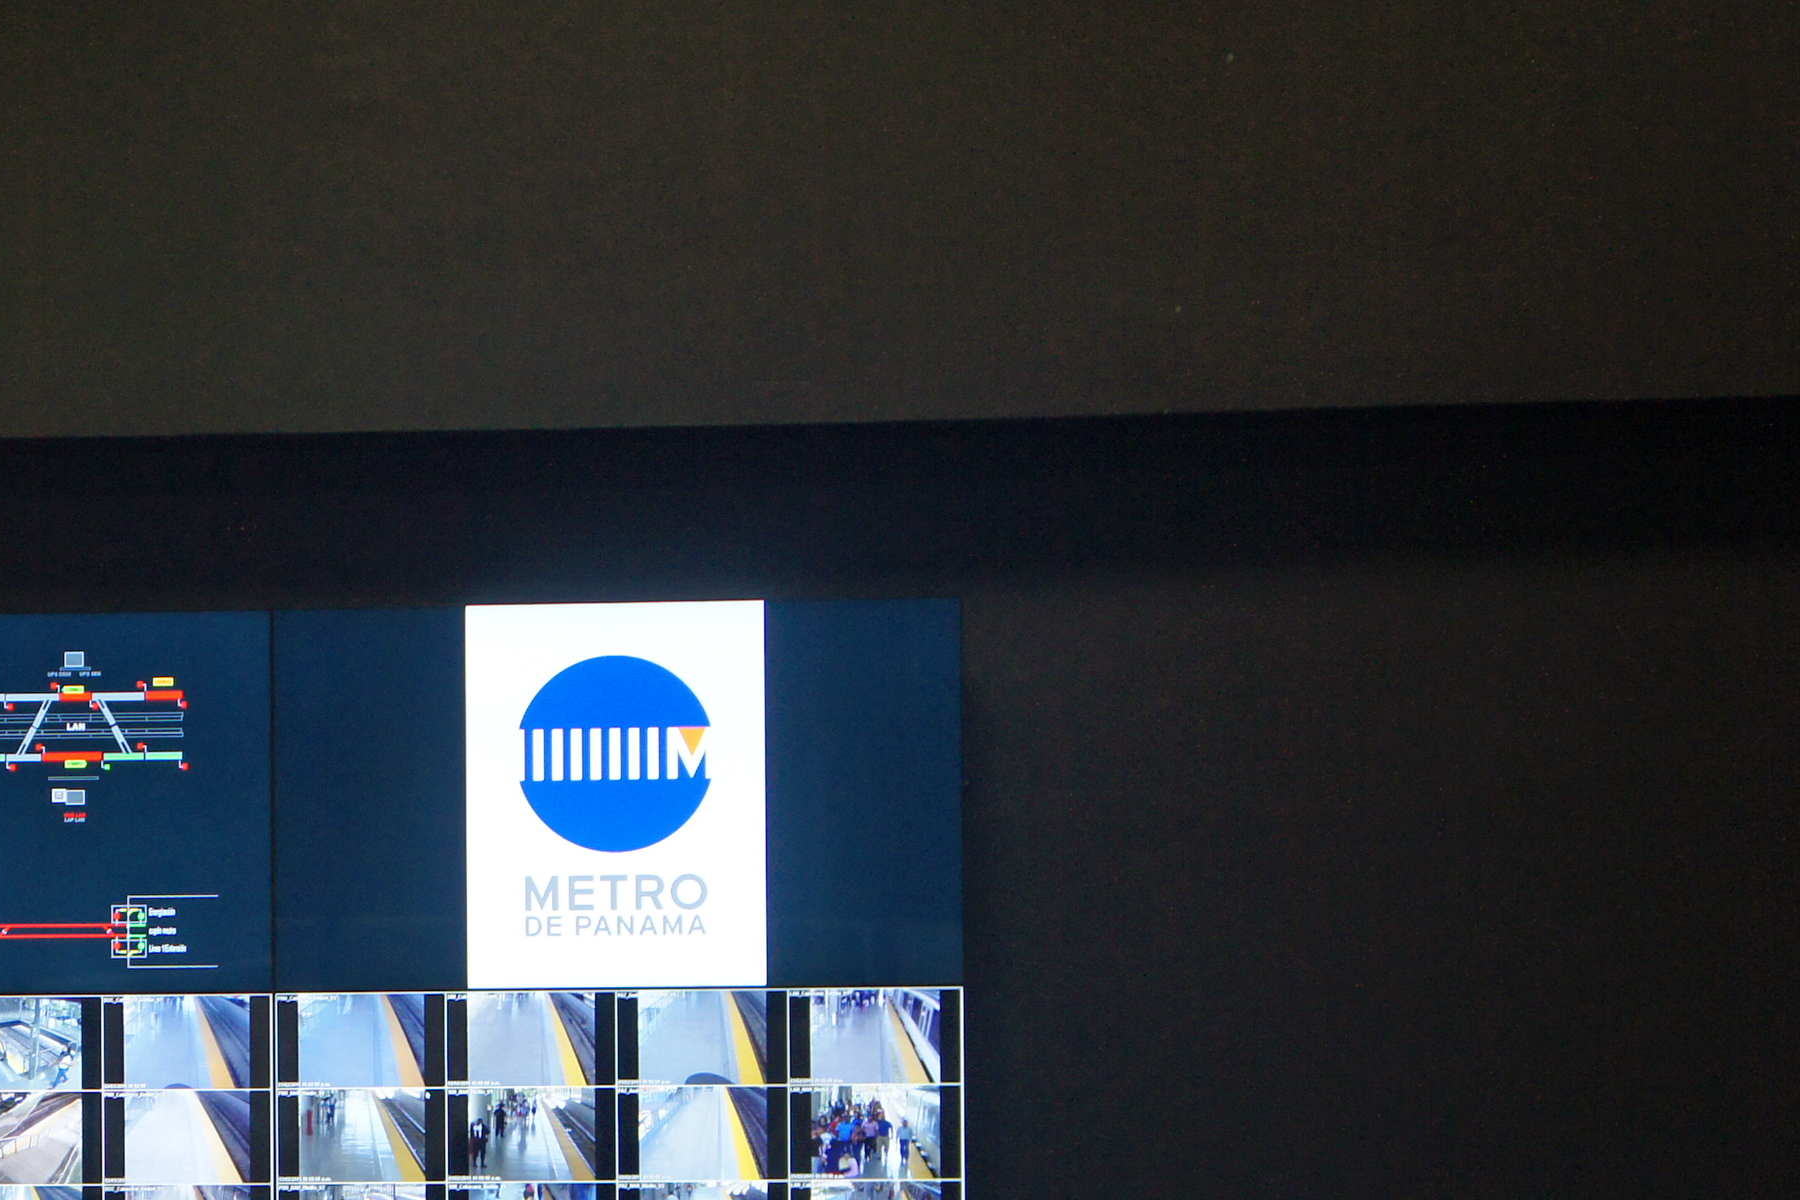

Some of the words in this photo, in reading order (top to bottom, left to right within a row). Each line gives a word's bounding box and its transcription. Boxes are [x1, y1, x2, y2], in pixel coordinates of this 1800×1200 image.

[66, 722, 86, 732] LAN
[524, 873, 708, 912] METRO
[525, 916, 562, 937] DE
